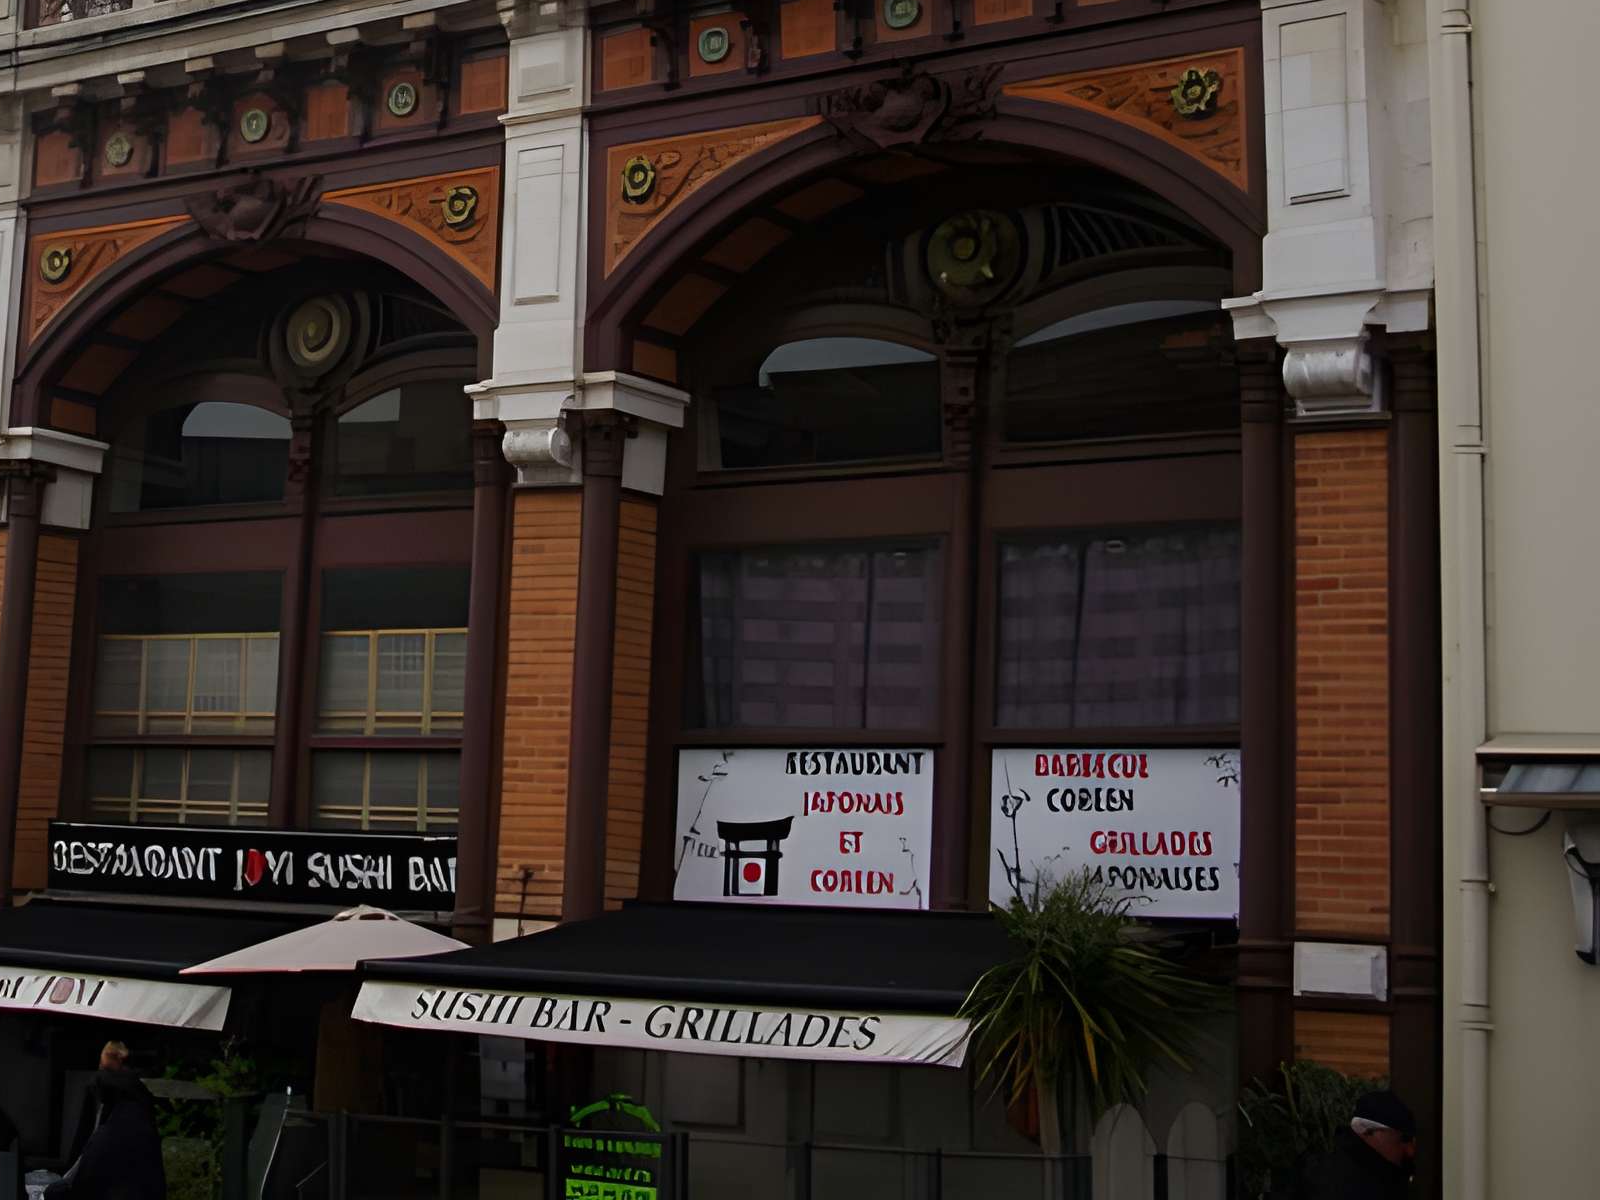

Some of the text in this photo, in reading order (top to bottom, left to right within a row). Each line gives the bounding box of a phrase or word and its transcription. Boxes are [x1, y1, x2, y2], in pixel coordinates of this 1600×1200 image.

[839, 831, 863, 854] ET
[411, 990, 526, 1025] SUSHI
[530, 997, 612, 1033] BAR
[644, 1004, 882, 1050] GRILLADES
